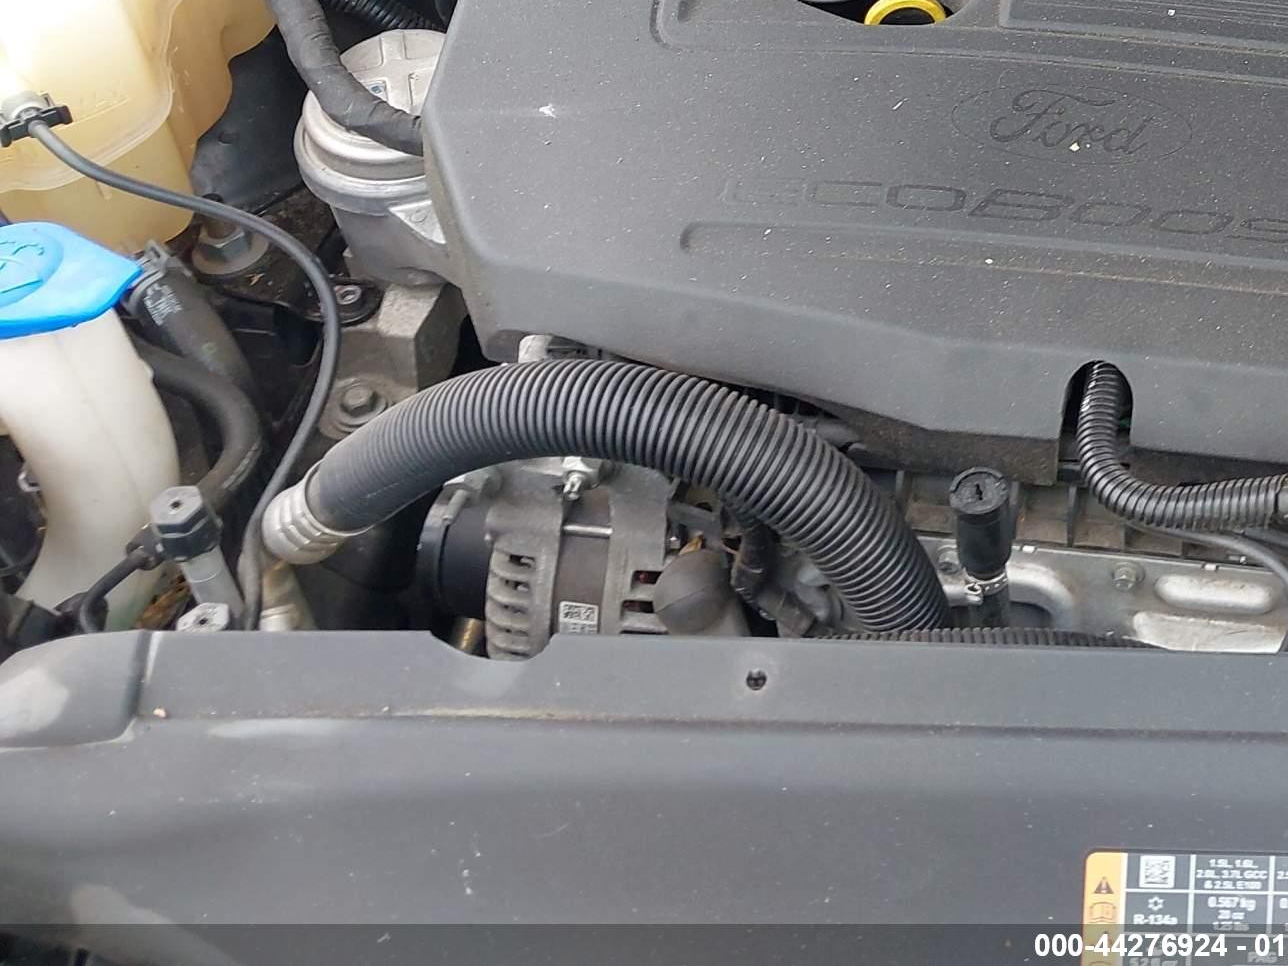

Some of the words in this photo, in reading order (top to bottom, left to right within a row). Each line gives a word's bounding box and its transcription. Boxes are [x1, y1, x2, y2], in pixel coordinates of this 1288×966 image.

[989, 89, 1152, 155] Ford
[1240, 897, 1256, 911] kg
[1133, 914, 1178, 925] R-134a
